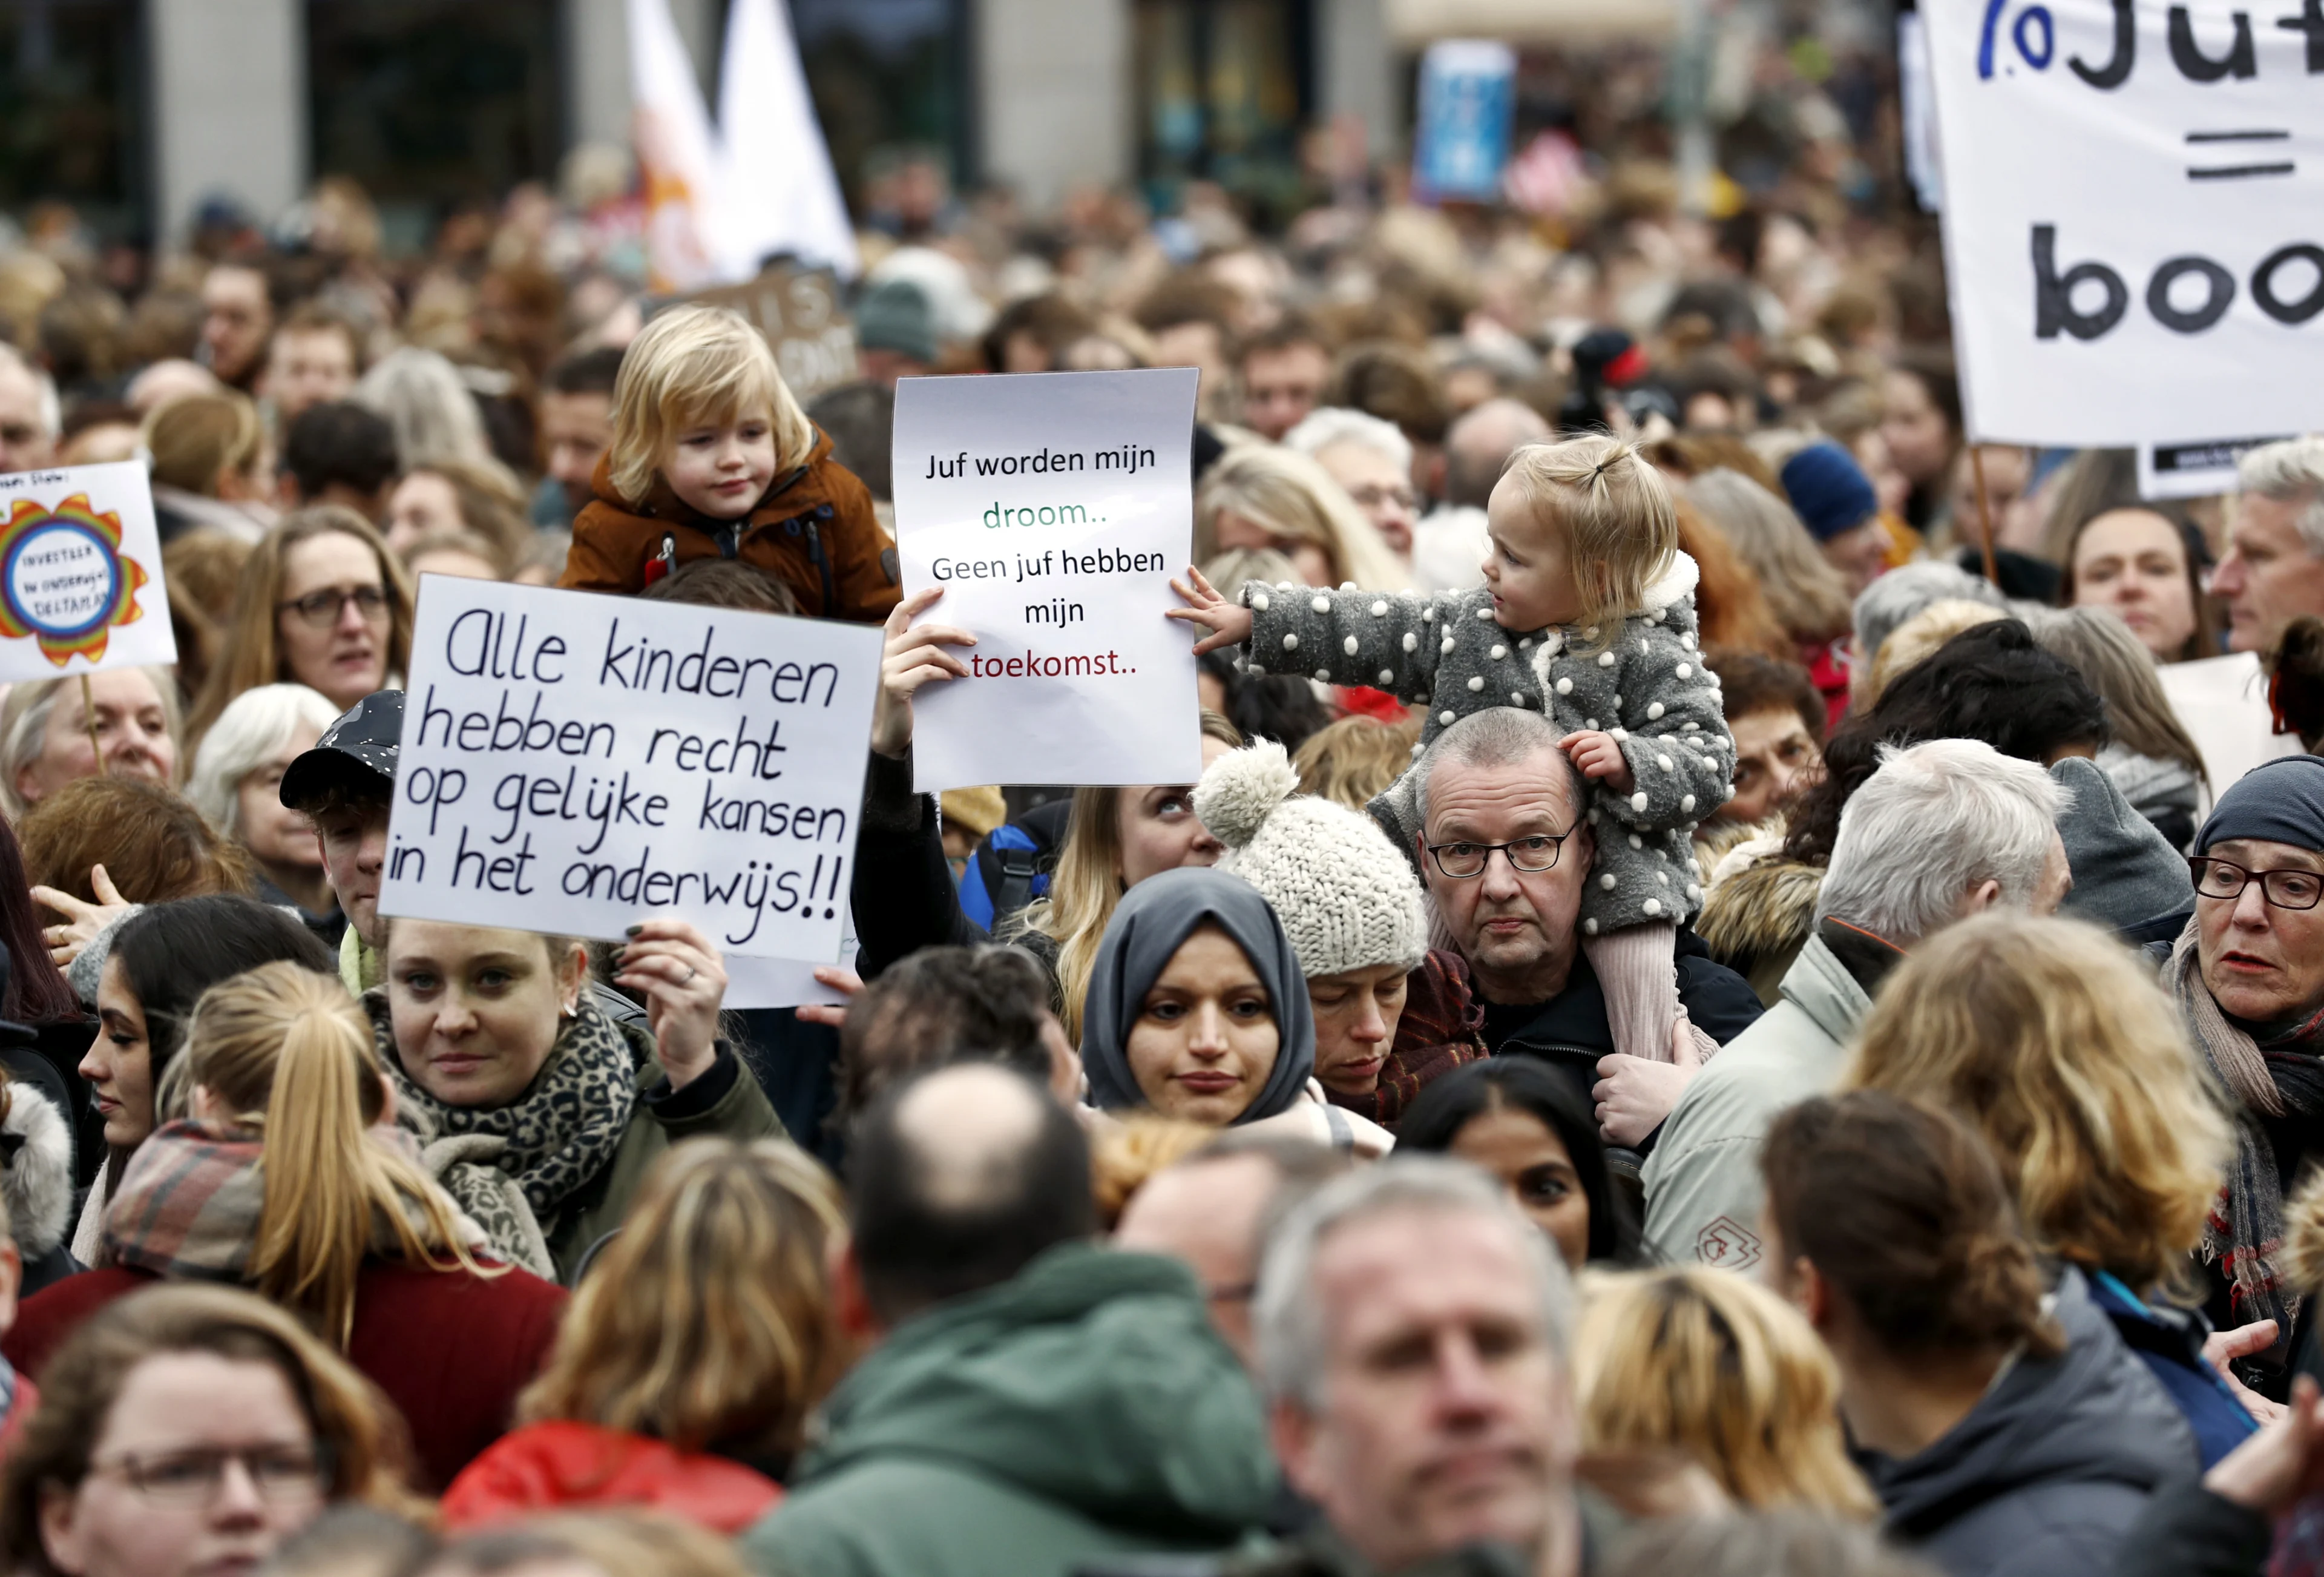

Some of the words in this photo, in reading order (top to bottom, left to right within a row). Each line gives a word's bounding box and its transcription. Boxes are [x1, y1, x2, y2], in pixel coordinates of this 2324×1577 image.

[925, 452, 968, 479] Juf
[975, 447, 1084, 477] worden
[1095, 444, 1155, 474] mijn
[983, 501, 1106, 528] droom..
[932, 557, 1006, 581] Geen
[1016, 551, 1052, 583] juf
[1062, 547, 1164, 575] hebben
[1025, 598, 1084, 629] mijn
[447, 608, 566, 683] Alle
[600, 617, 839, 708] kinderen
[971, 650, 1137, 678] toekomst..
[418, 685, 615, 759] hebben
[646, 716, 787, 781] recht
[407, 766, 467, 836] op
[490, 765, 668, 855] gelijke
[699, 779, 846, 843] kansen
[389, 835, 425, 883] in
[451, 826, 536, 895] het
[562, 846, 843, 946] onderwijs!!
